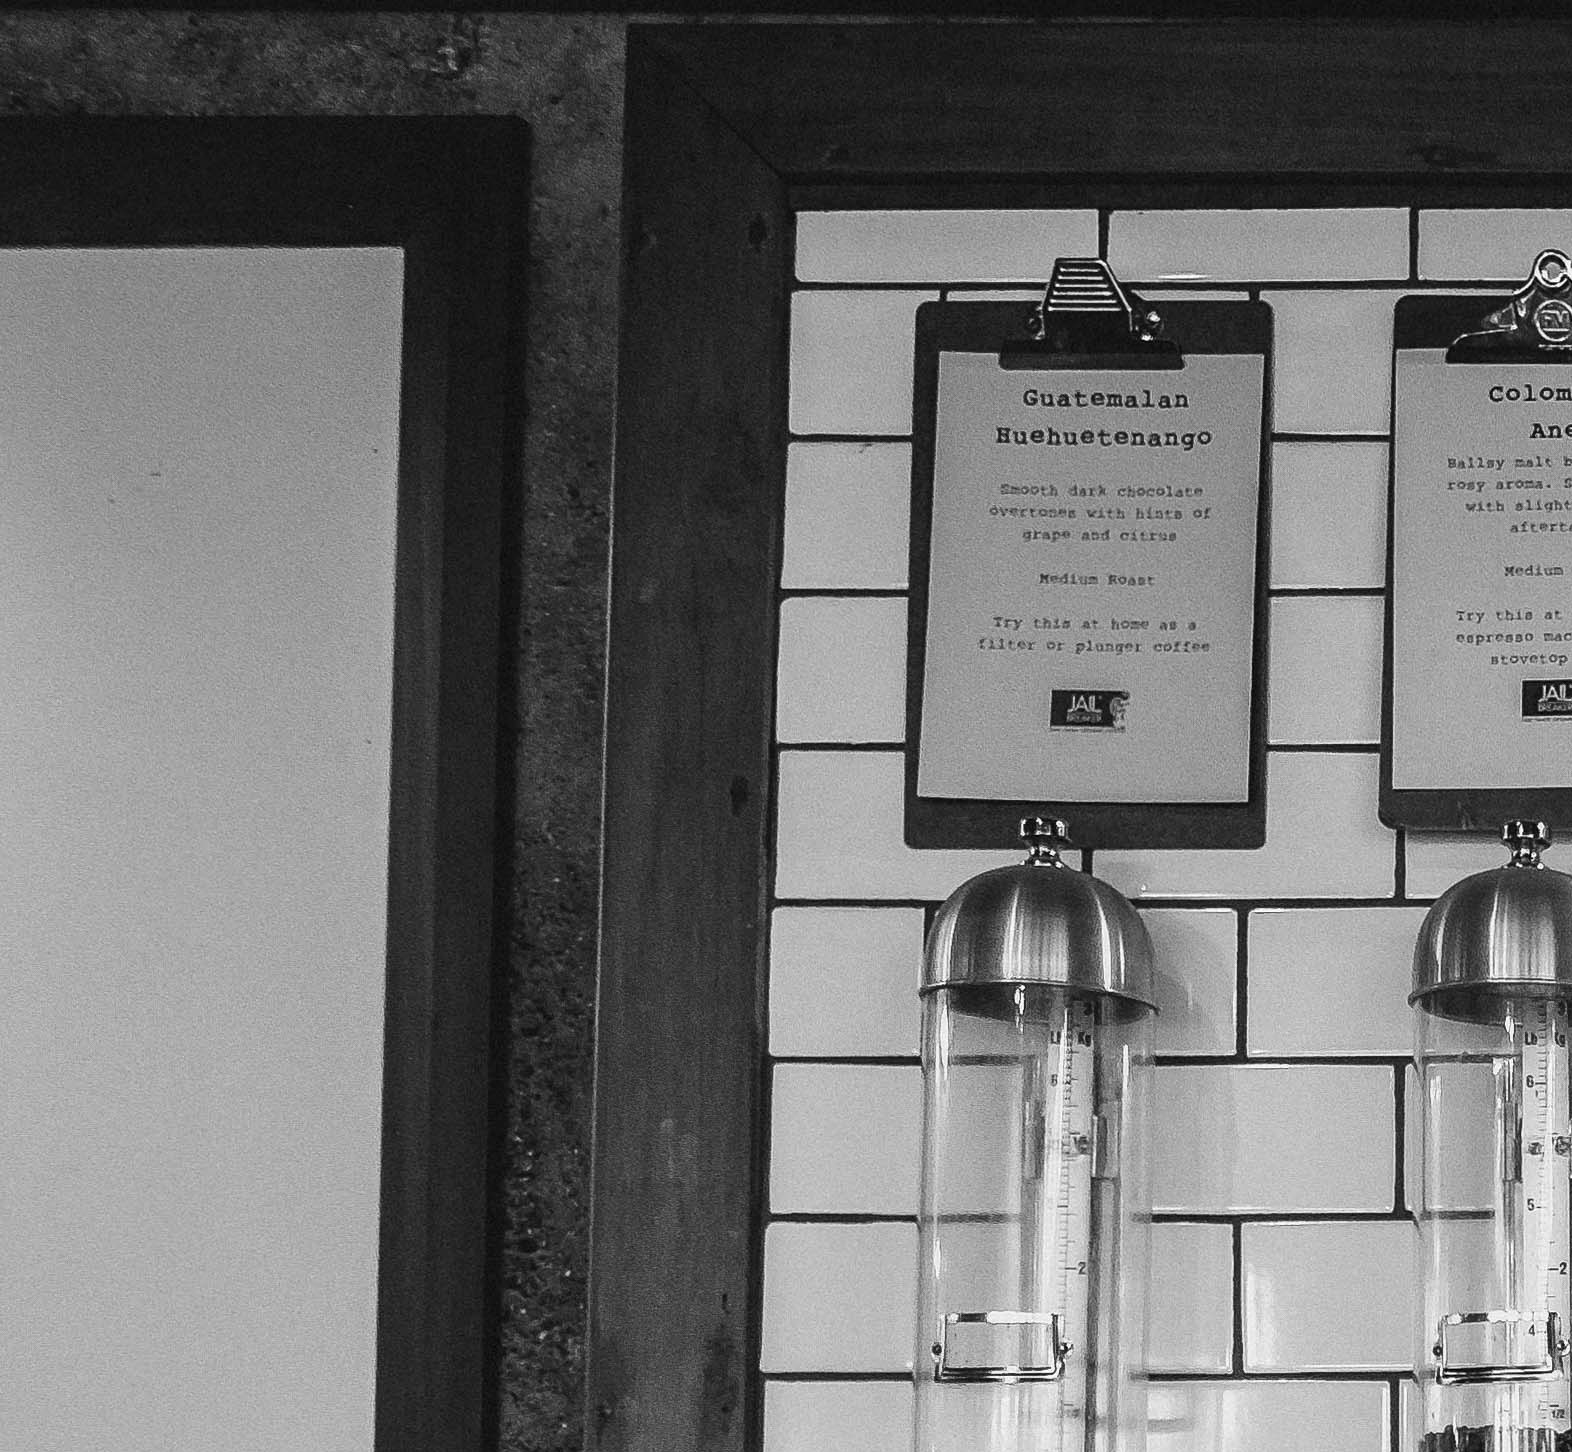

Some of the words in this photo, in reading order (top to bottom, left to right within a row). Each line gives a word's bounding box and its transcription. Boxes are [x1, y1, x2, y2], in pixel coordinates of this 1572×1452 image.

[1022, 388, 1189, 409] Guatemalan
[995, 426, 1213, 452] Huehuetenango
[1514, 455, 1552, 468] malt
[1446, 480, 1486, 494] rosy
[1495, 479, 1552, 491] aroma.
[1465, 500, 1505, 513] with
[1504, 564, 1564, 577] Medium
[1039, 572, 1099, 586] Medium
[1107, 573, 1155, 587] Roast
[1455, 610, 1486, 625] Try
[1495, 609, 1533, 622] this
[1543, 609, 1563, 621] at
[1455, 632, 1534, 647] espresso
[1490, 653, 1569, 667] stovetop
[1539, 685, 1572, 701] JAIL
[1067, 695, 1105, 713] JAIL
